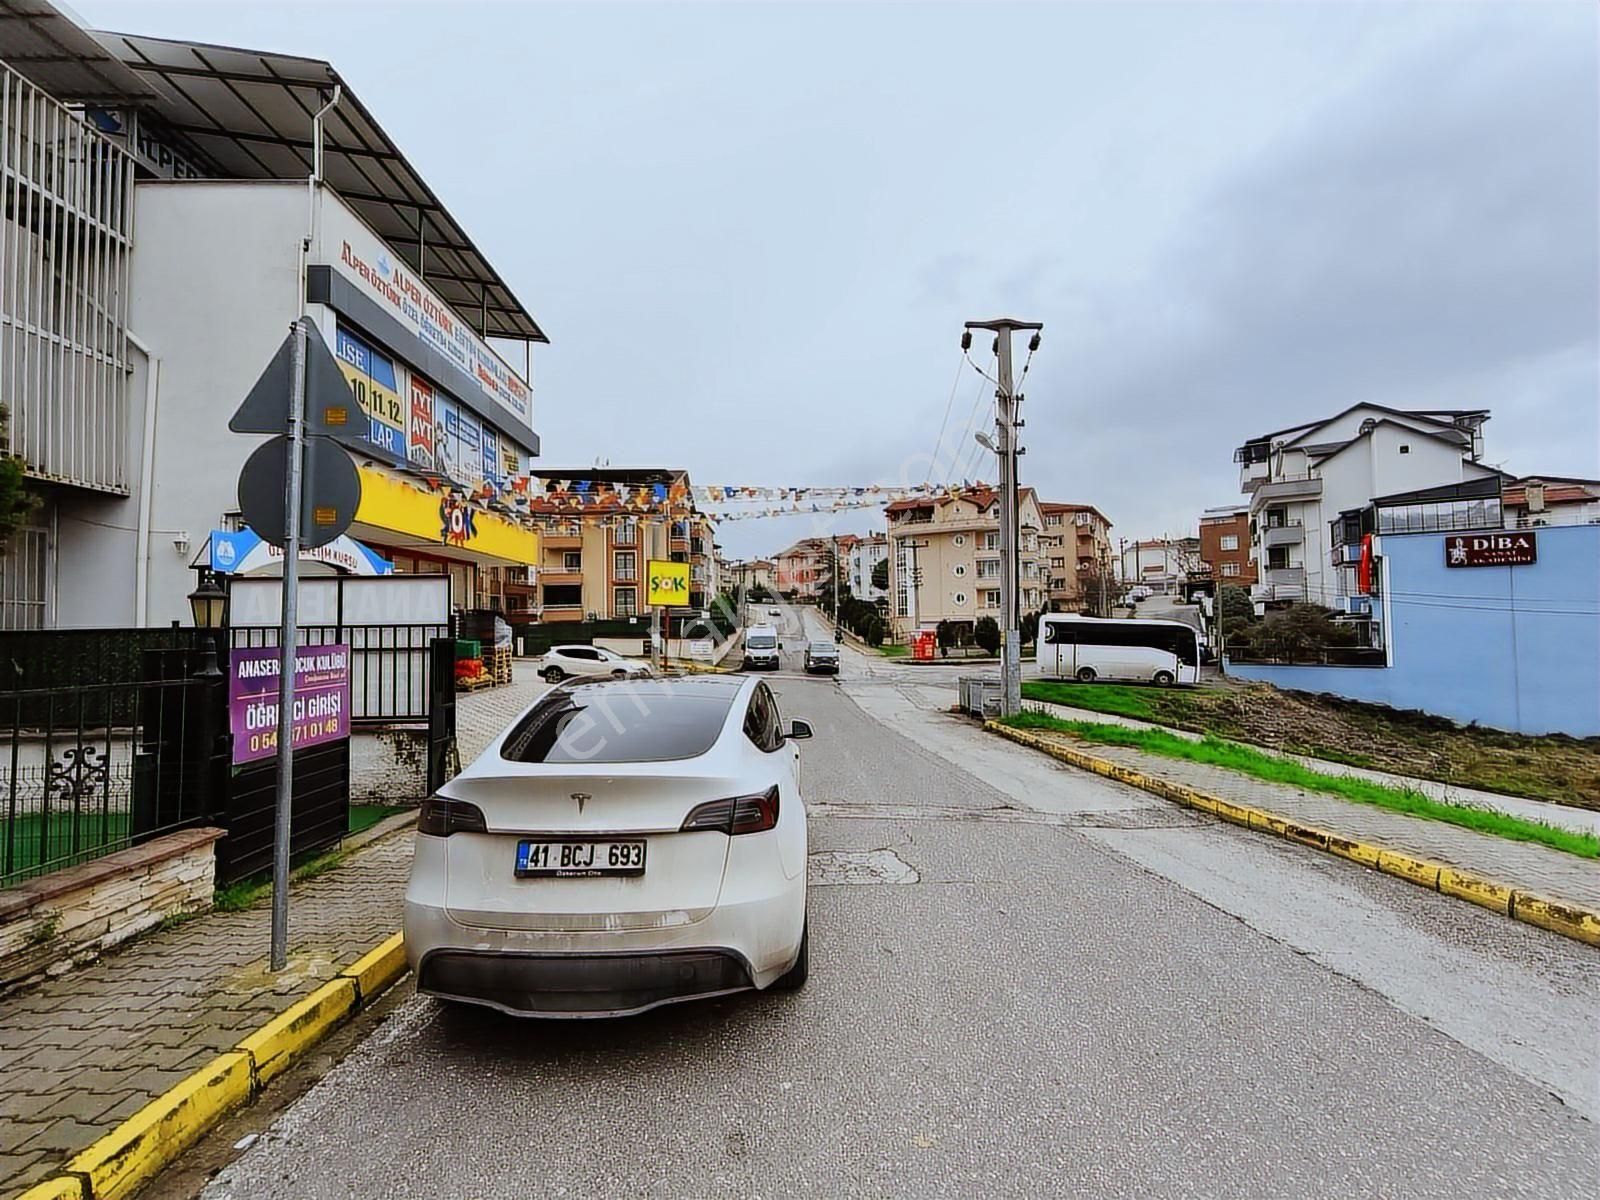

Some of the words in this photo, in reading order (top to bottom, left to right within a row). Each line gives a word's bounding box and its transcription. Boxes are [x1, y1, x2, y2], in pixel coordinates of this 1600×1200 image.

[341, 240, 370, 283] ALPER
[370, 268, 402, 309] ÖZTÜRK
[392, 268, 421, 308] ALPER
[351, 378, 369, 407] 10.
[412, 386, 432, 413] TYT
[412, 415, 432, 441] AYT
[1473, 534, 1530, 550] DİBA
[651, 575, 687, 594] ŞOK
[238, 659, 281, 679] ANASER
[308, 690, 341, 718] GİRİŞİ
[251, 735, 259, 752] 0
[529, 845, 549, 867] 41
[560, 845, 595, 867] BCJ
[608, 844, 642, 866] 693
